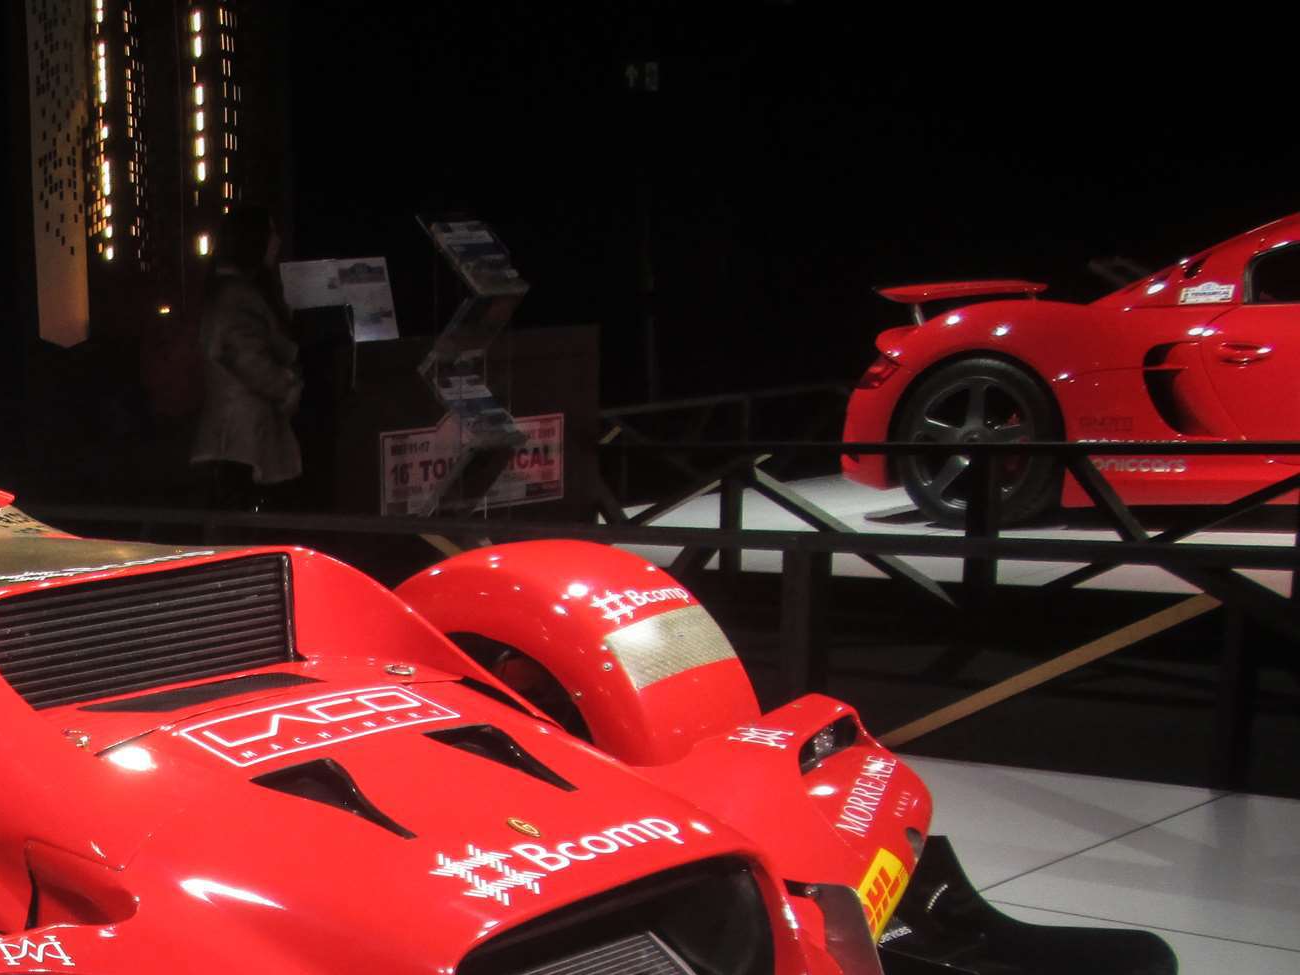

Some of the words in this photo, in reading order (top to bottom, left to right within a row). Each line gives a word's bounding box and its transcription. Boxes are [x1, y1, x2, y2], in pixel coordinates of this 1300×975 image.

[624, 587, 690, 607] Bcomp
[202, 691, 422, 746] LACO
[241, 709, 443, 759] MACHINERY
[835, 755, 897, 838] MORREALE
[510, 817, 685, 872] Bcomp
